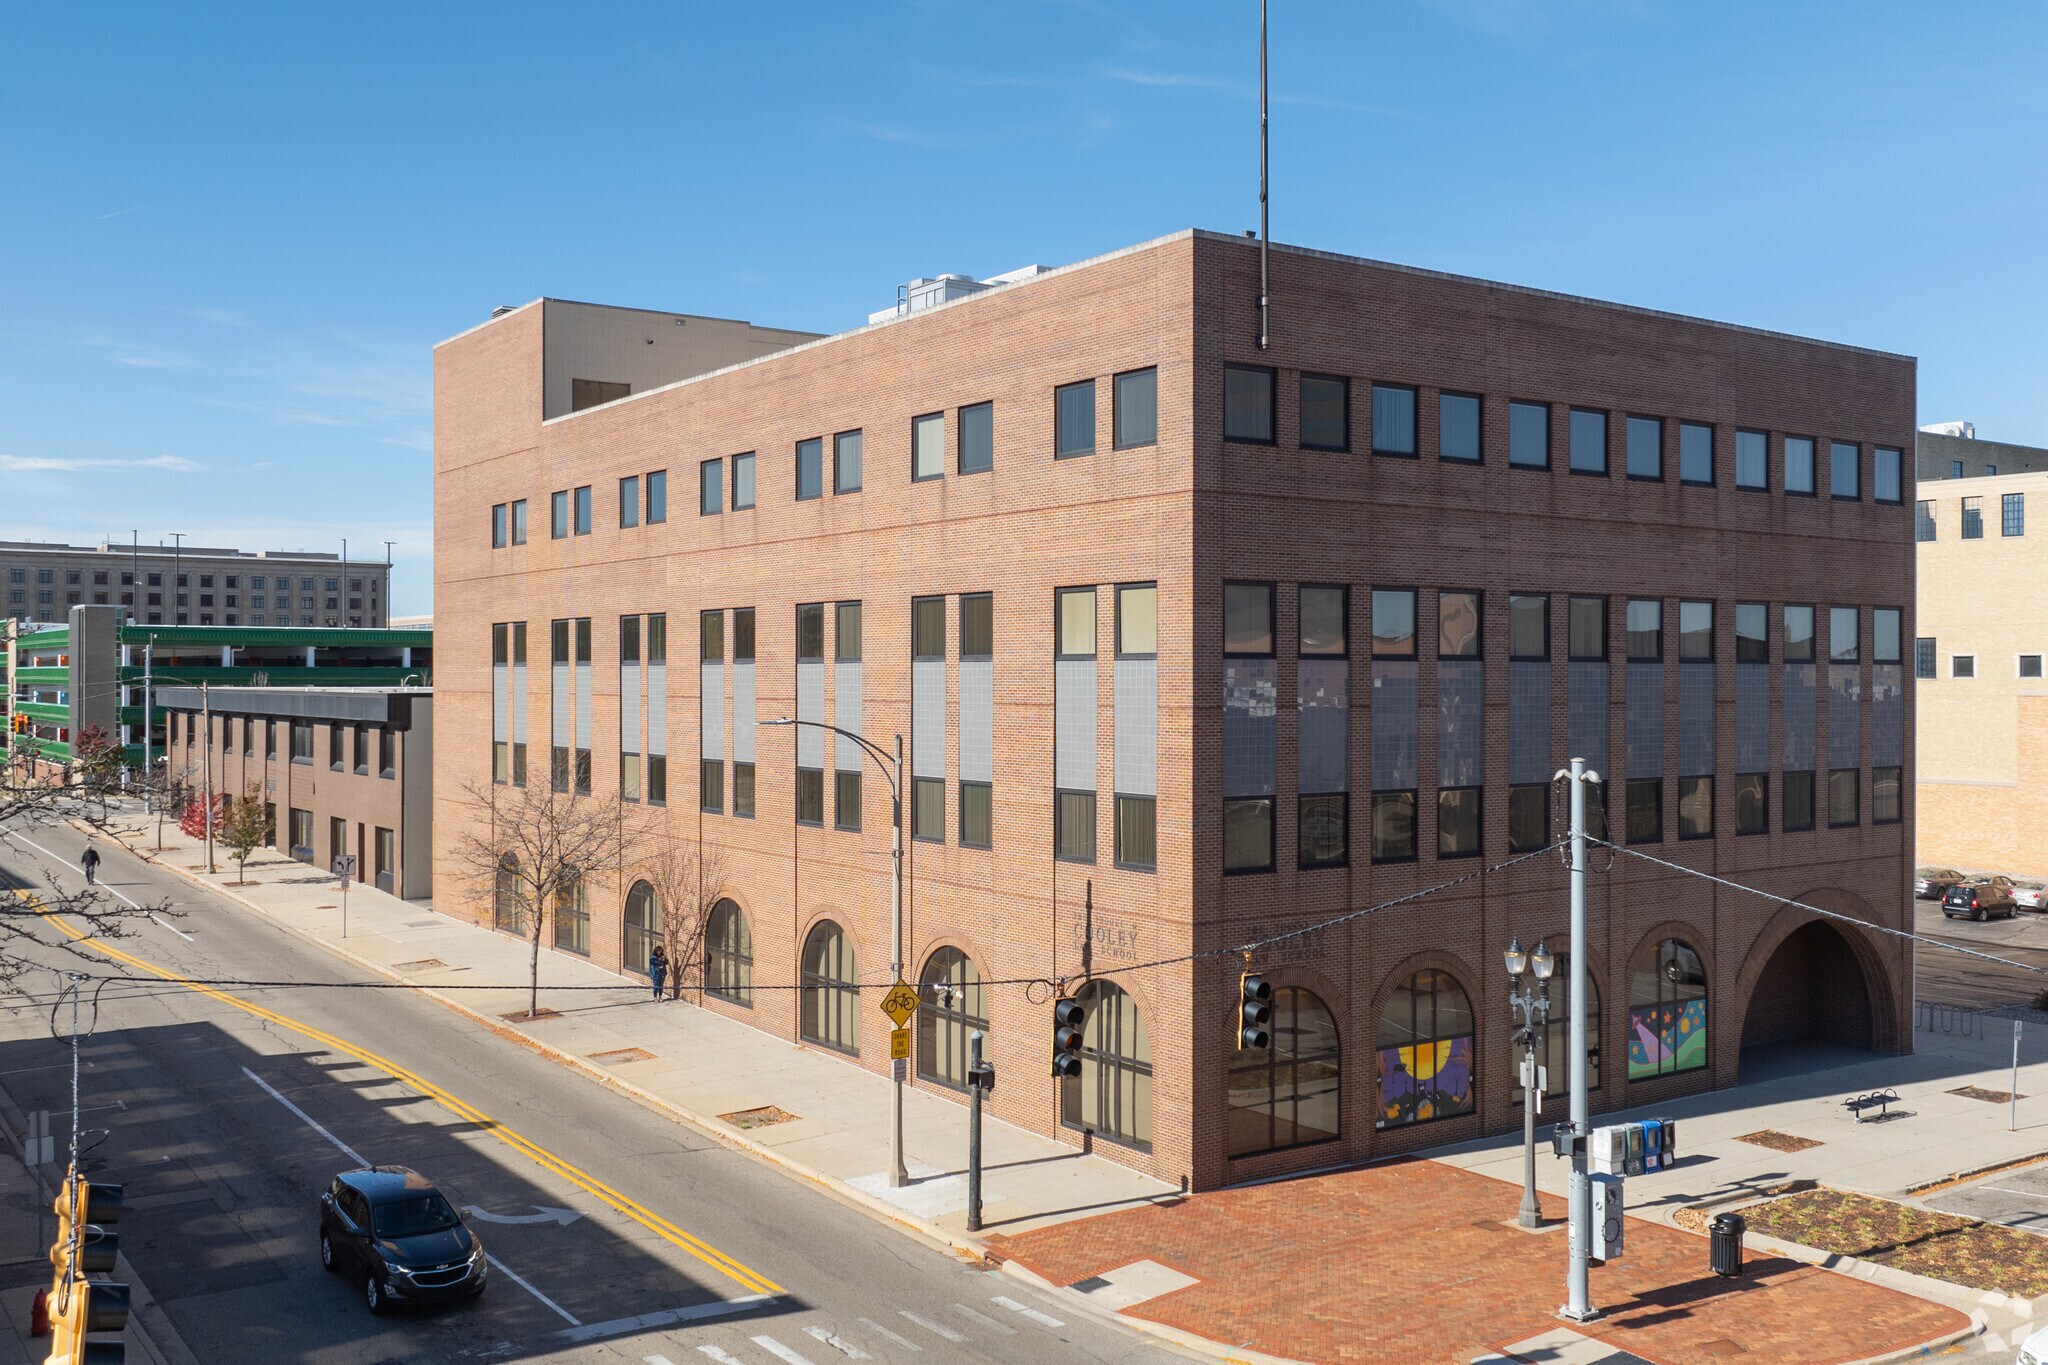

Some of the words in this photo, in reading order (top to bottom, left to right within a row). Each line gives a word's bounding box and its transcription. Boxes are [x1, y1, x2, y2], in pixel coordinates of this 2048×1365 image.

[1074, 923, 1138, 949] COOLEY
[1101, 947, 1137, 961] SCHOOL
[893, 1032, 907, 1040] SHARE
[894, 1048, 906, 1056] ROAD
